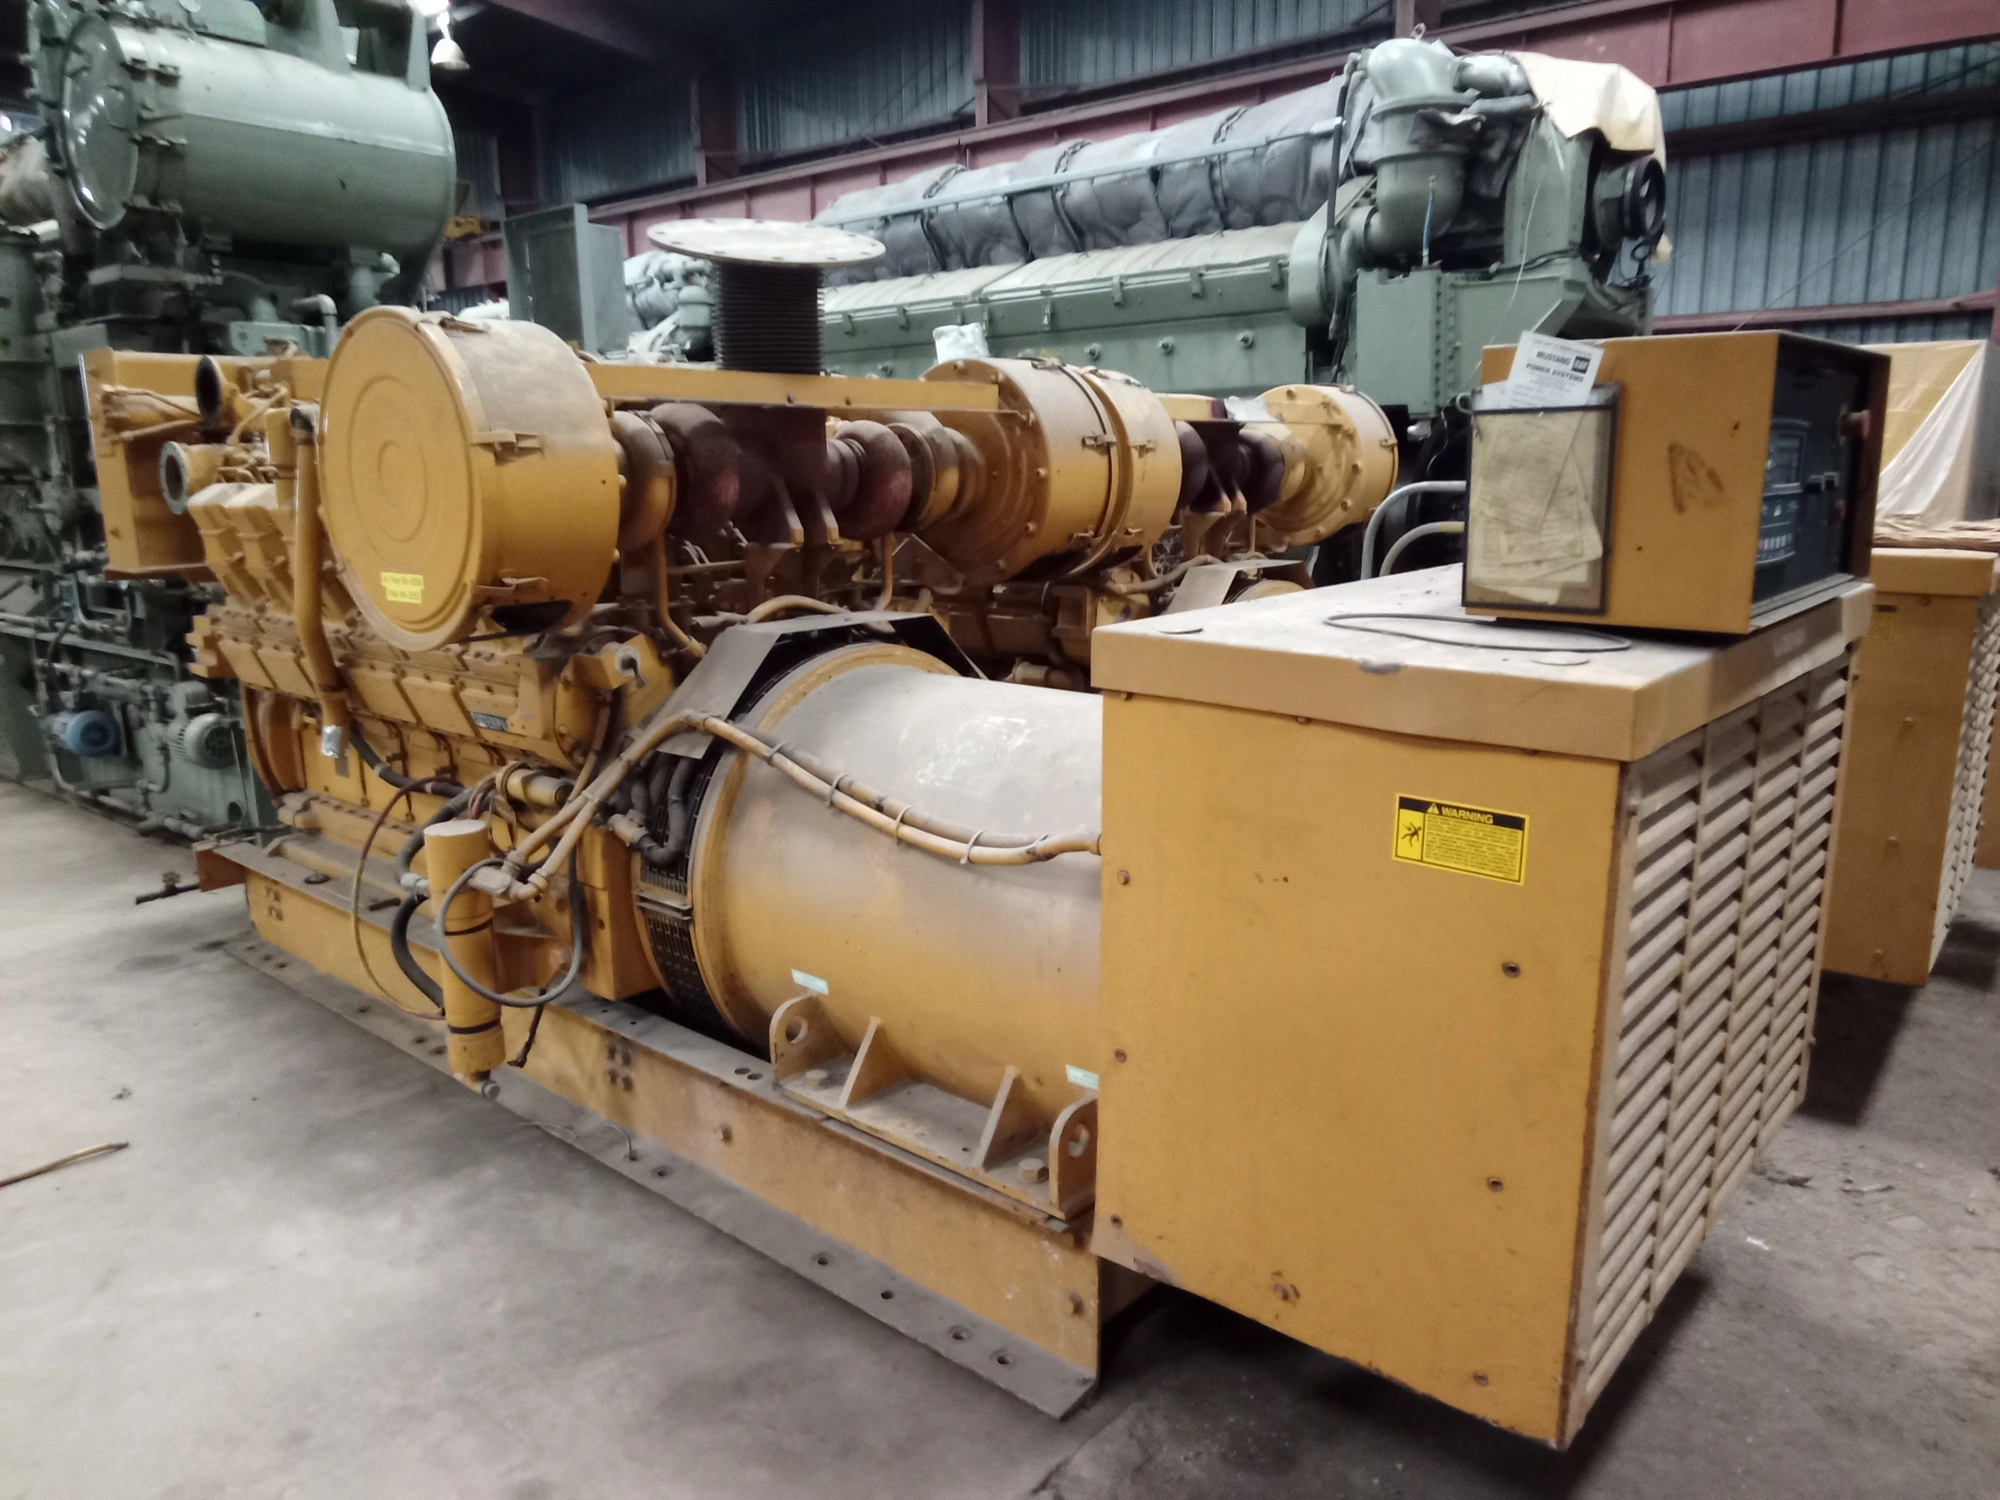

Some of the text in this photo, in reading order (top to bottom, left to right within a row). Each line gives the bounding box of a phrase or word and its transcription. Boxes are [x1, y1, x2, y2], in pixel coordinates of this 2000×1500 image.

[1536, 351, 1571, 366] MUSTANG
[1526, 363, 1550, 374] POWER
[1552, 370, 1584, 383] SYSTEMS
[1441, 806, 1494, 825] WARNING
